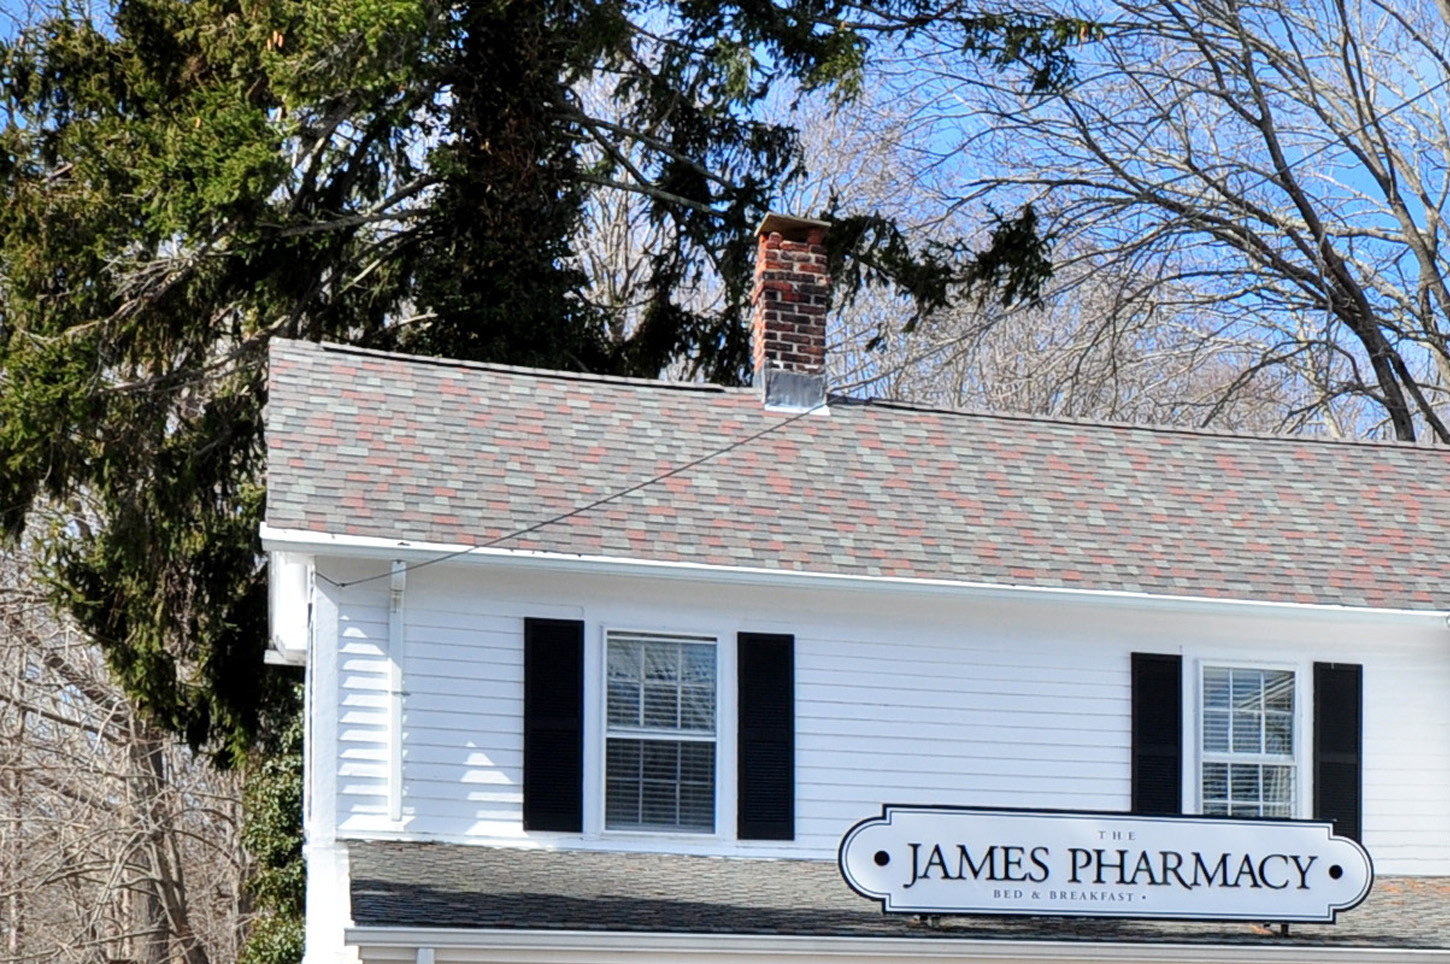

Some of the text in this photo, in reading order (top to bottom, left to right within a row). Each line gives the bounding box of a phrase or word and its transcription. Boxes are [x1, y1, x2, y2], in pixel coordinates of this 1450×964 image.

[1098, 830, 1136, 841] THE
[903, 842, 1319, 890] JAMES PHARMACY
[993, 889, 1134, 901] BED & BREAKFAST
